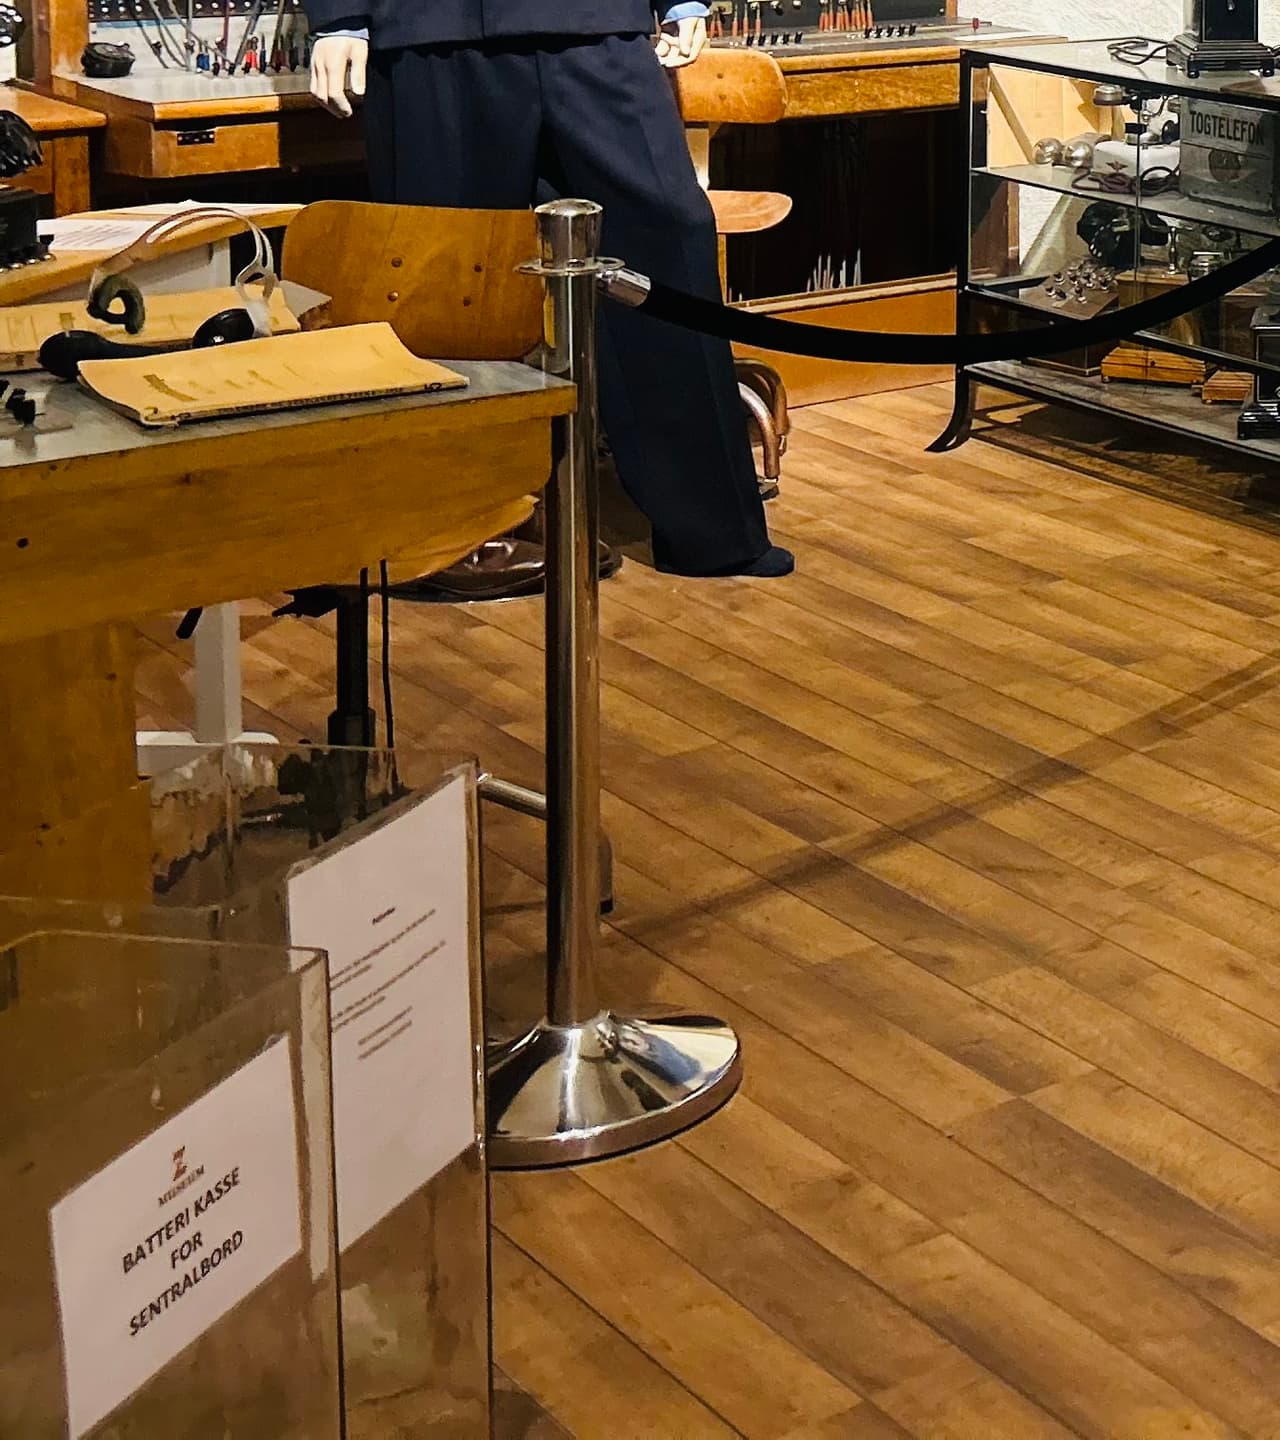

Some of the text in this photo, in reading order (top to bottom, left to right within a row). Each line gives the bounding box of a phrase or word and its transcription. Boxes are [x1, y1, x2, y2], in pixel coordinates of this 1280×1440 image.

[1189, 110, 1265, 145] TOGTELEFON
[158, 1165, 205, 1207] MUSEUM
[122, 1166, 241, 1274] BATTERI KASSE
[170, 1231, 204, 1270] FOR
[129, 1229, 244, 1336] SENTRALBORD
